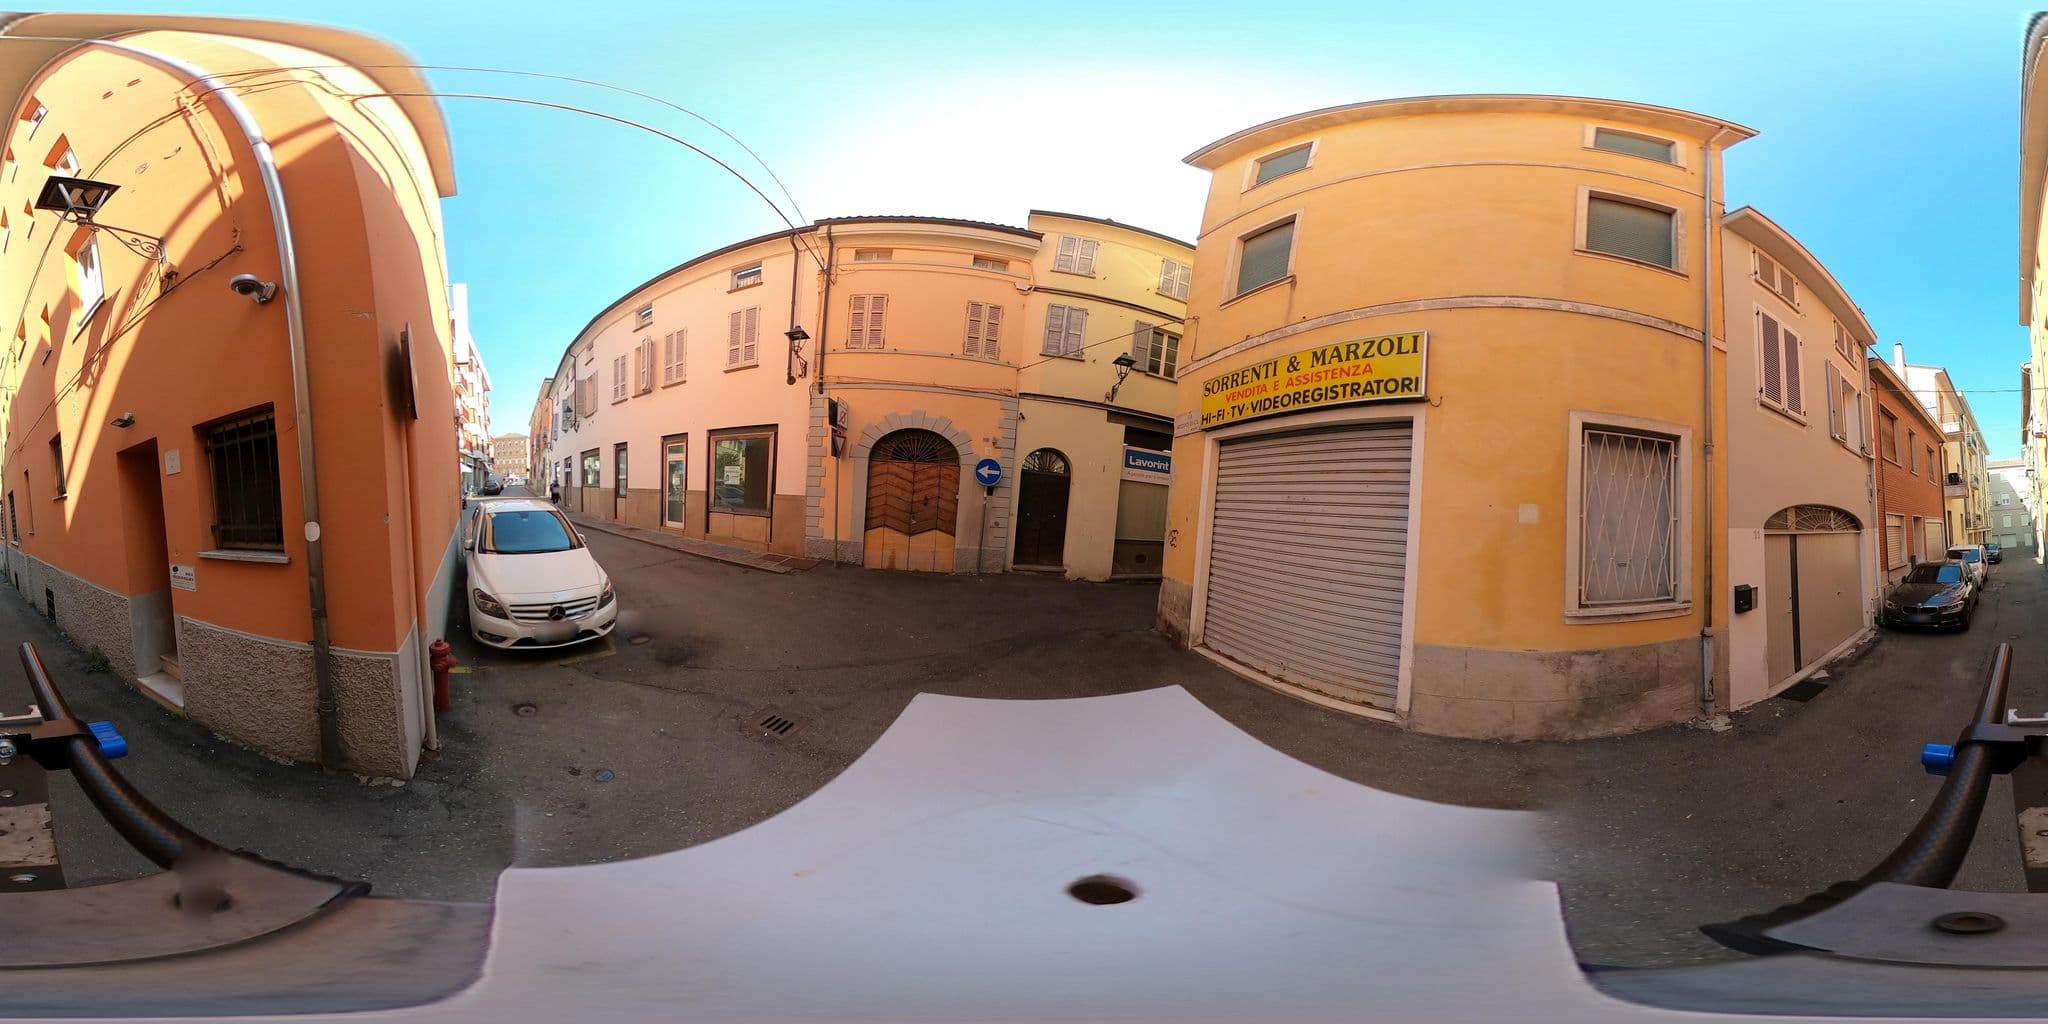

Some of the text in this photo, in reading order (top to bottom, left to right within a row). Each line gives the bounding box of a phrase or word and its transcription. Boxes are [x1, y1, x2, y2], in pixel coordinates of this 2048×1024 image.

[1203, 335, 1420, 397] SORRENTI & MARZOLI
[1225, 363, 1374, 403] VENDITA E ASSISTENZA
[1250, 376, 1420, 414] VIDEOREGISTRATORI
[1129, 455, 1170, 471] Lavorint
